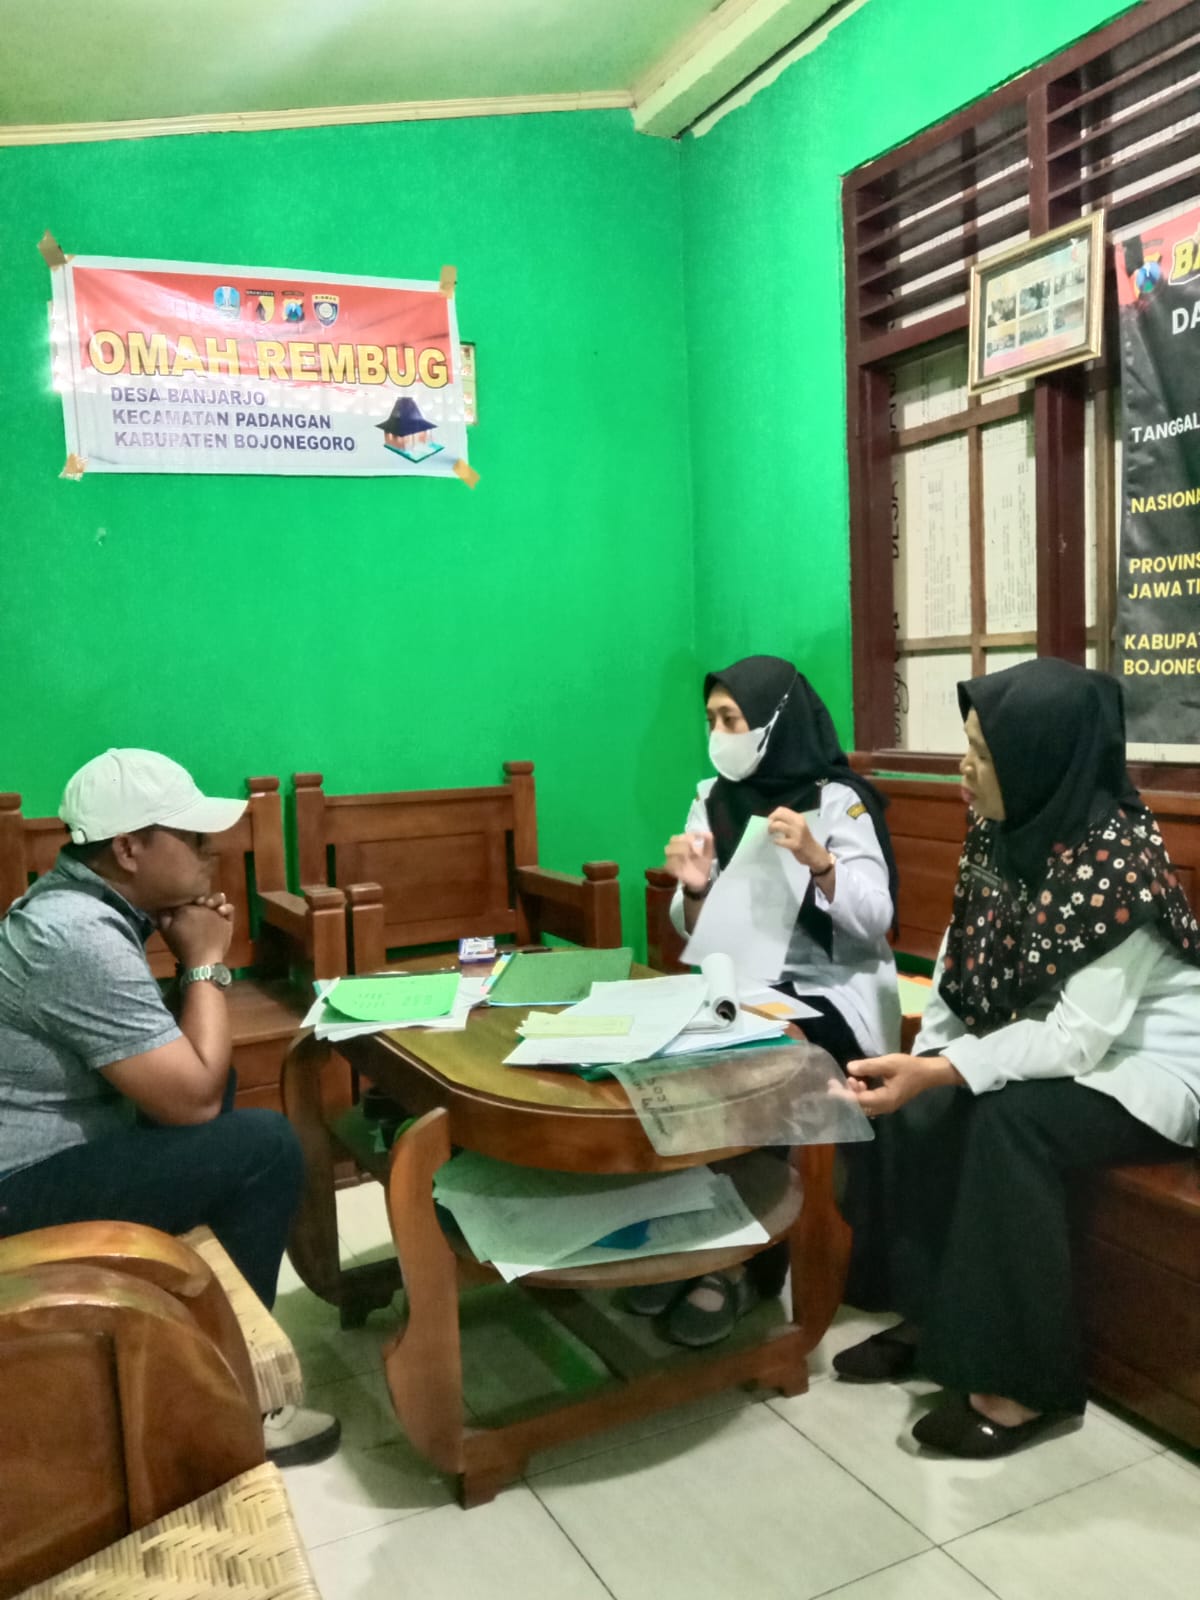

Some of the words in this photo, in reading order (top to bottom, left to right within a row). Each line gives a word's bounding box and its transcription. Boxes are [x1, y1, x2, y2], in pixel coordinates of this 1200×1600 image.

[88, 330, 241, 377] OMAH
[255, 339, 449, 389] REMBUG
[111, 386, 161, 403] DESA
[167, 388, 266, 406] BANJARJO
[112, 408, 229, 427] KECAMATAN
[235, 412, 331, 429] PADANGAN
[1131, 411, 1200, 444] TANGGAL
[114, 431, 227, 449] KABUPATEN
[234, 434, 355, 451] BOJONEGORO
[1131, 487, 1200, 514] NASION
[1128, 580, 1183, 600] JAWA
[1124, 631, 1200, 651] KABUPA
